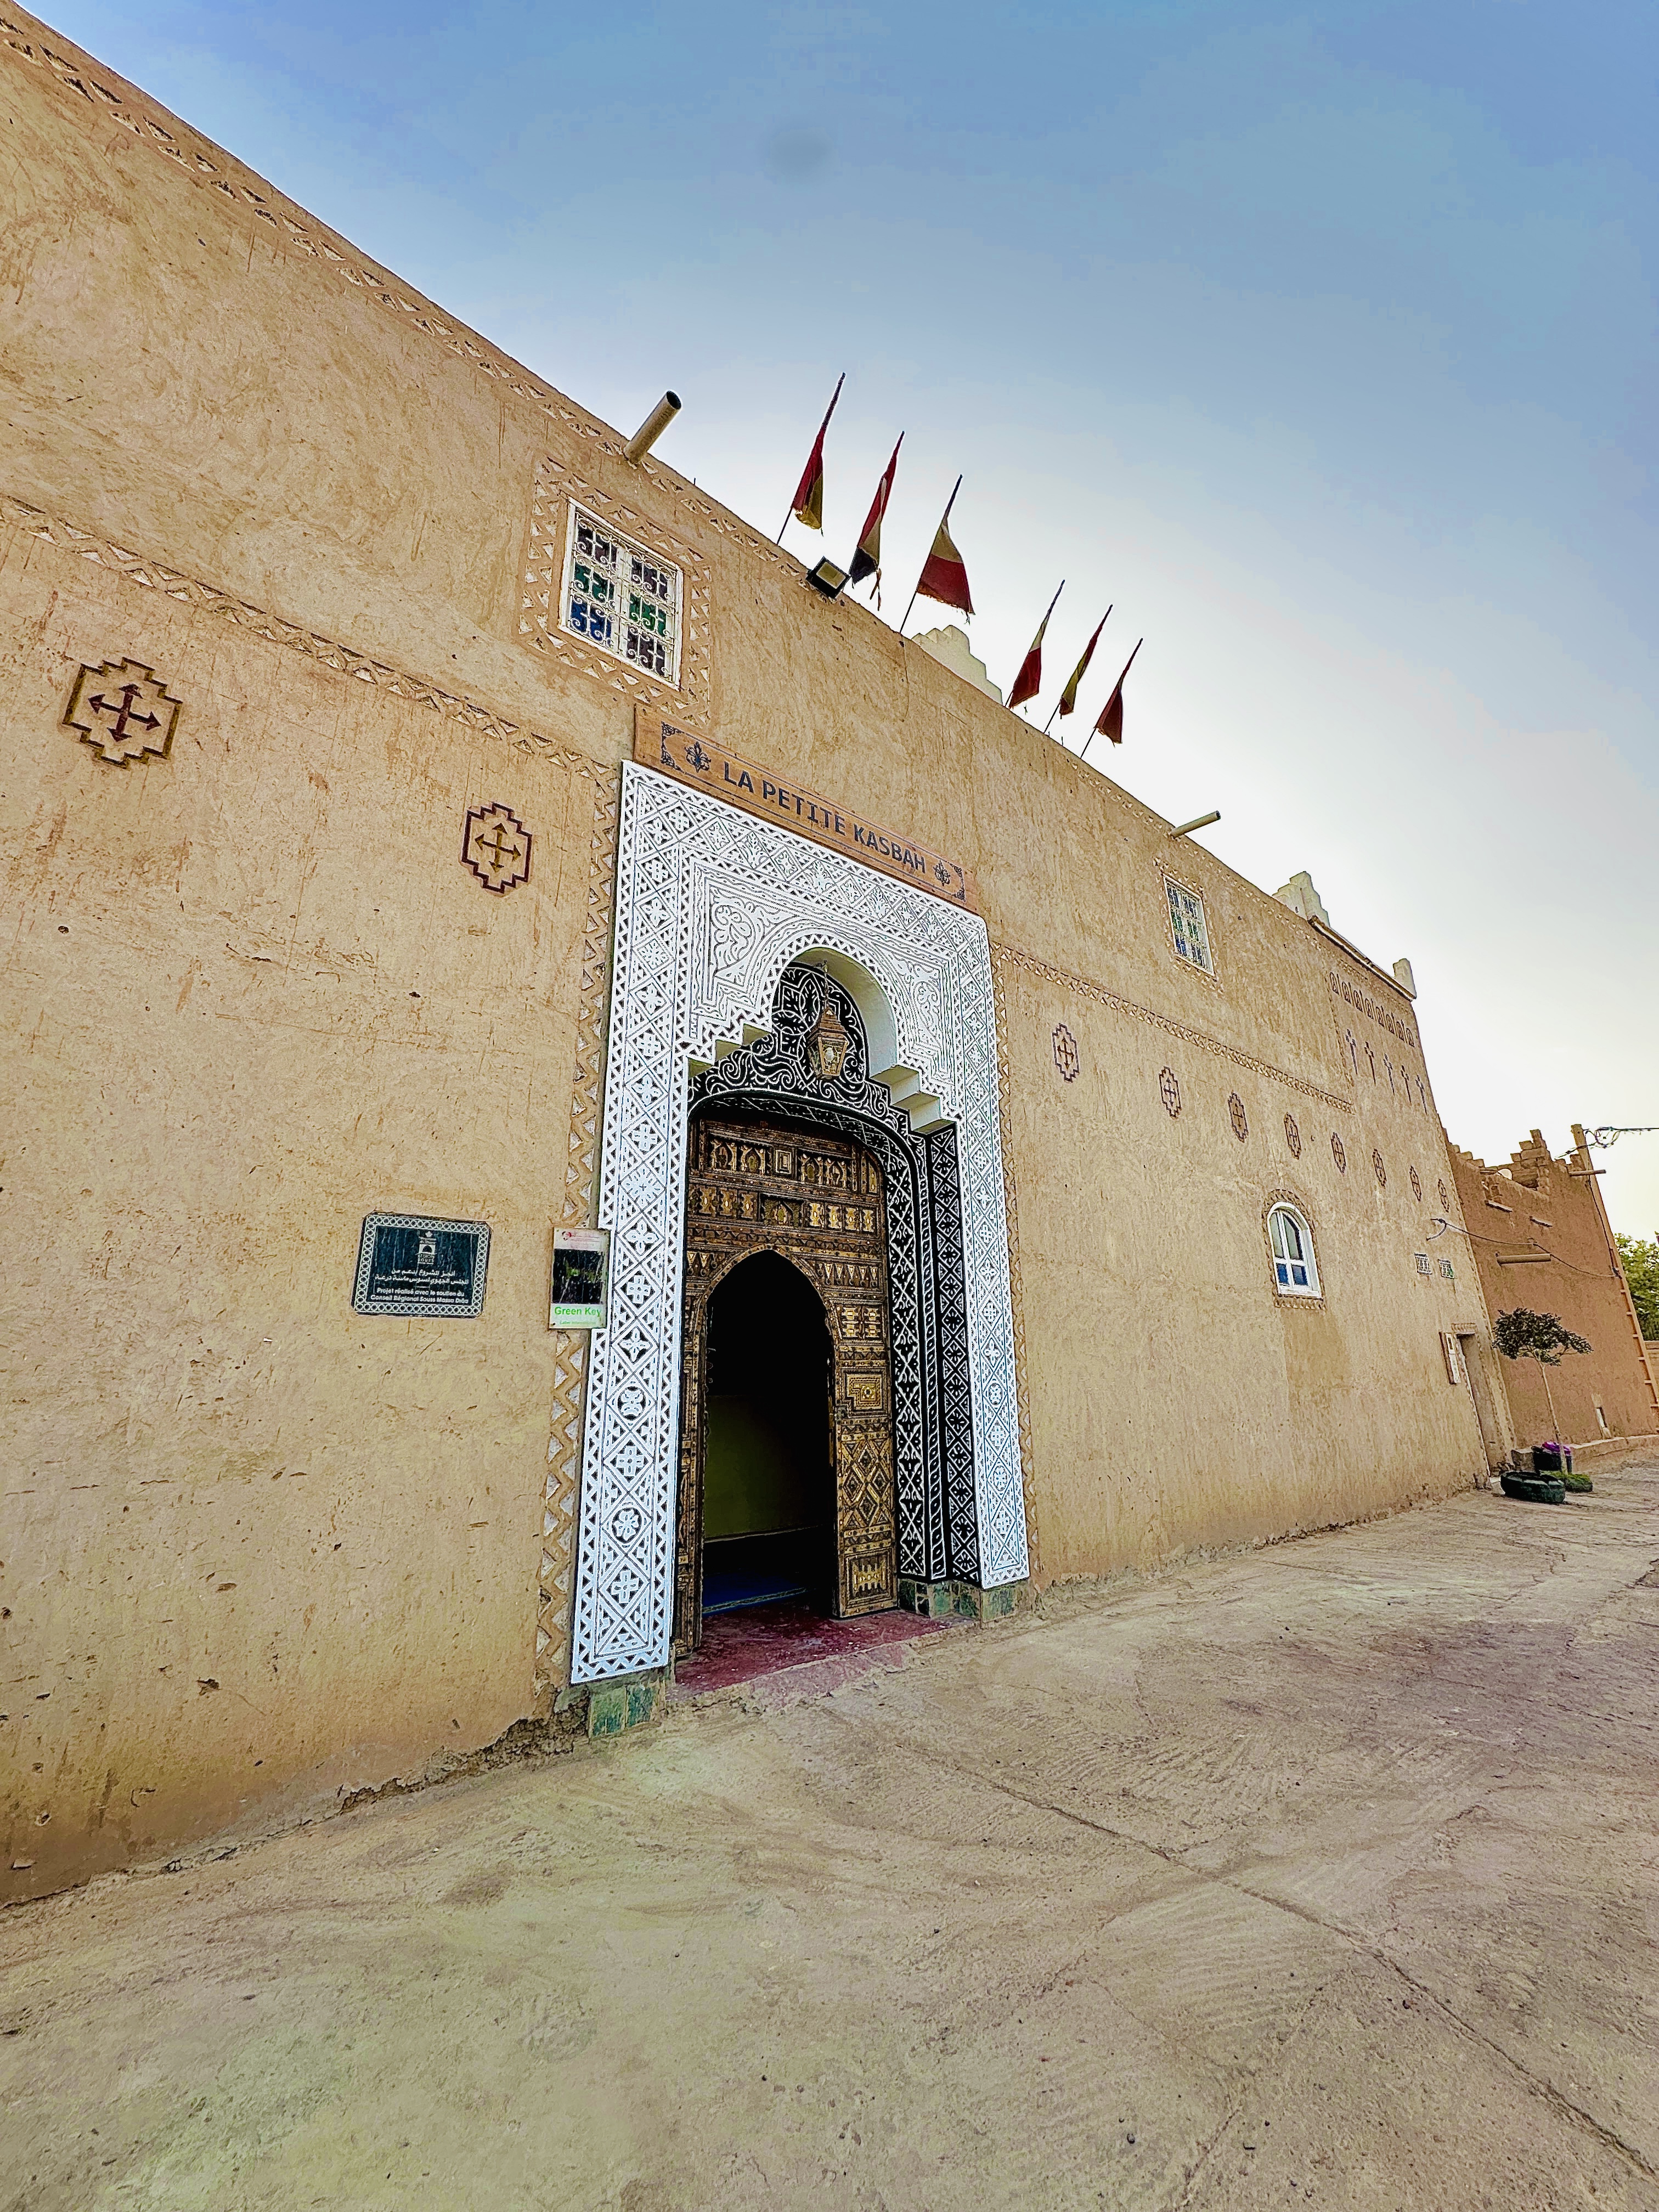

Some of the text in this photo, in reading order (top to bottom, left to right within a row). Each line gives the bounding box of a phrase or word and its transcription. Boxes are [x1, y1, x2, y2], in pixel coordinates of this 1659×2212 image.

[724, 761, 926, 873] LA PETITE KASBAH
[555, 1306, 601, 1317] Green Key
